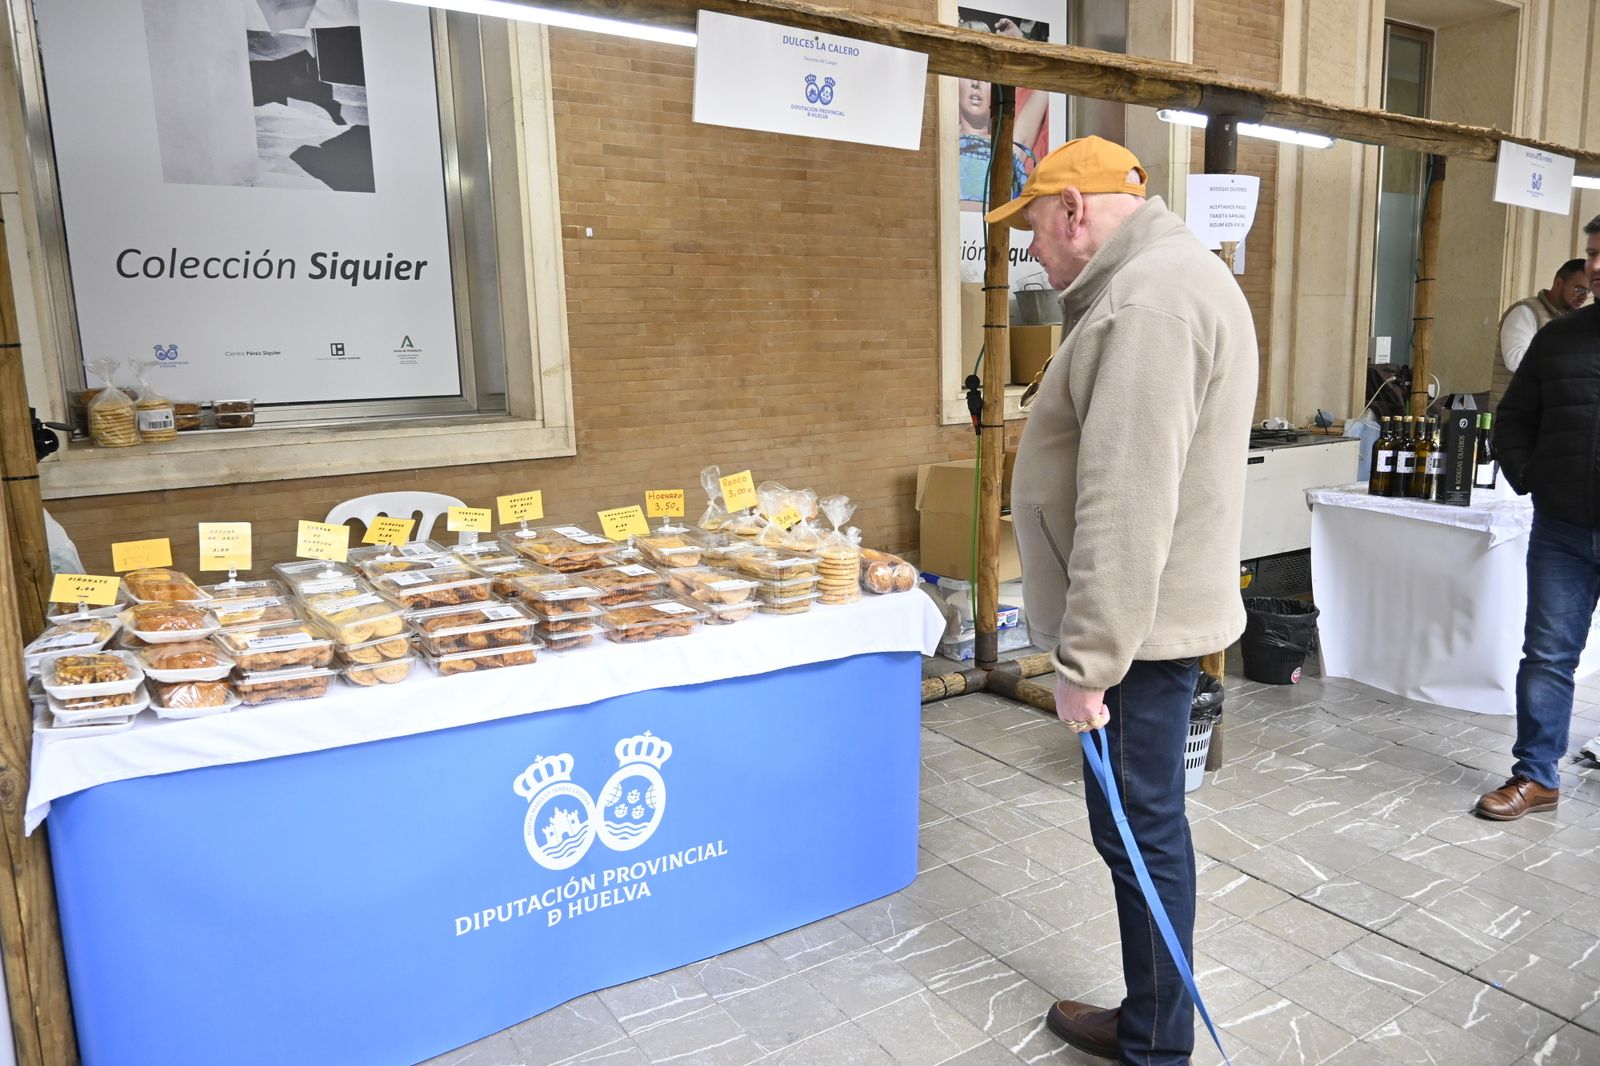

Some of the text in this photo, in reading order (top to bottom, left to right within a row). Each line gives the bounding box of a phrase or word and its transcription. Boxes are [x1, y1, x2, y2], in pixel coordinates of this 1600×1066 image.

[783, 36, 860, 57] DULCES LA CALERO
[116, 247, 428, 287] Colección Siquier
[1455, 461, 1463, 485] BODEGAS
[455, 840, 728, 936] DIPUTACIÓN PROVINCIAL
[568, 881, 652, 919] HUELVA
